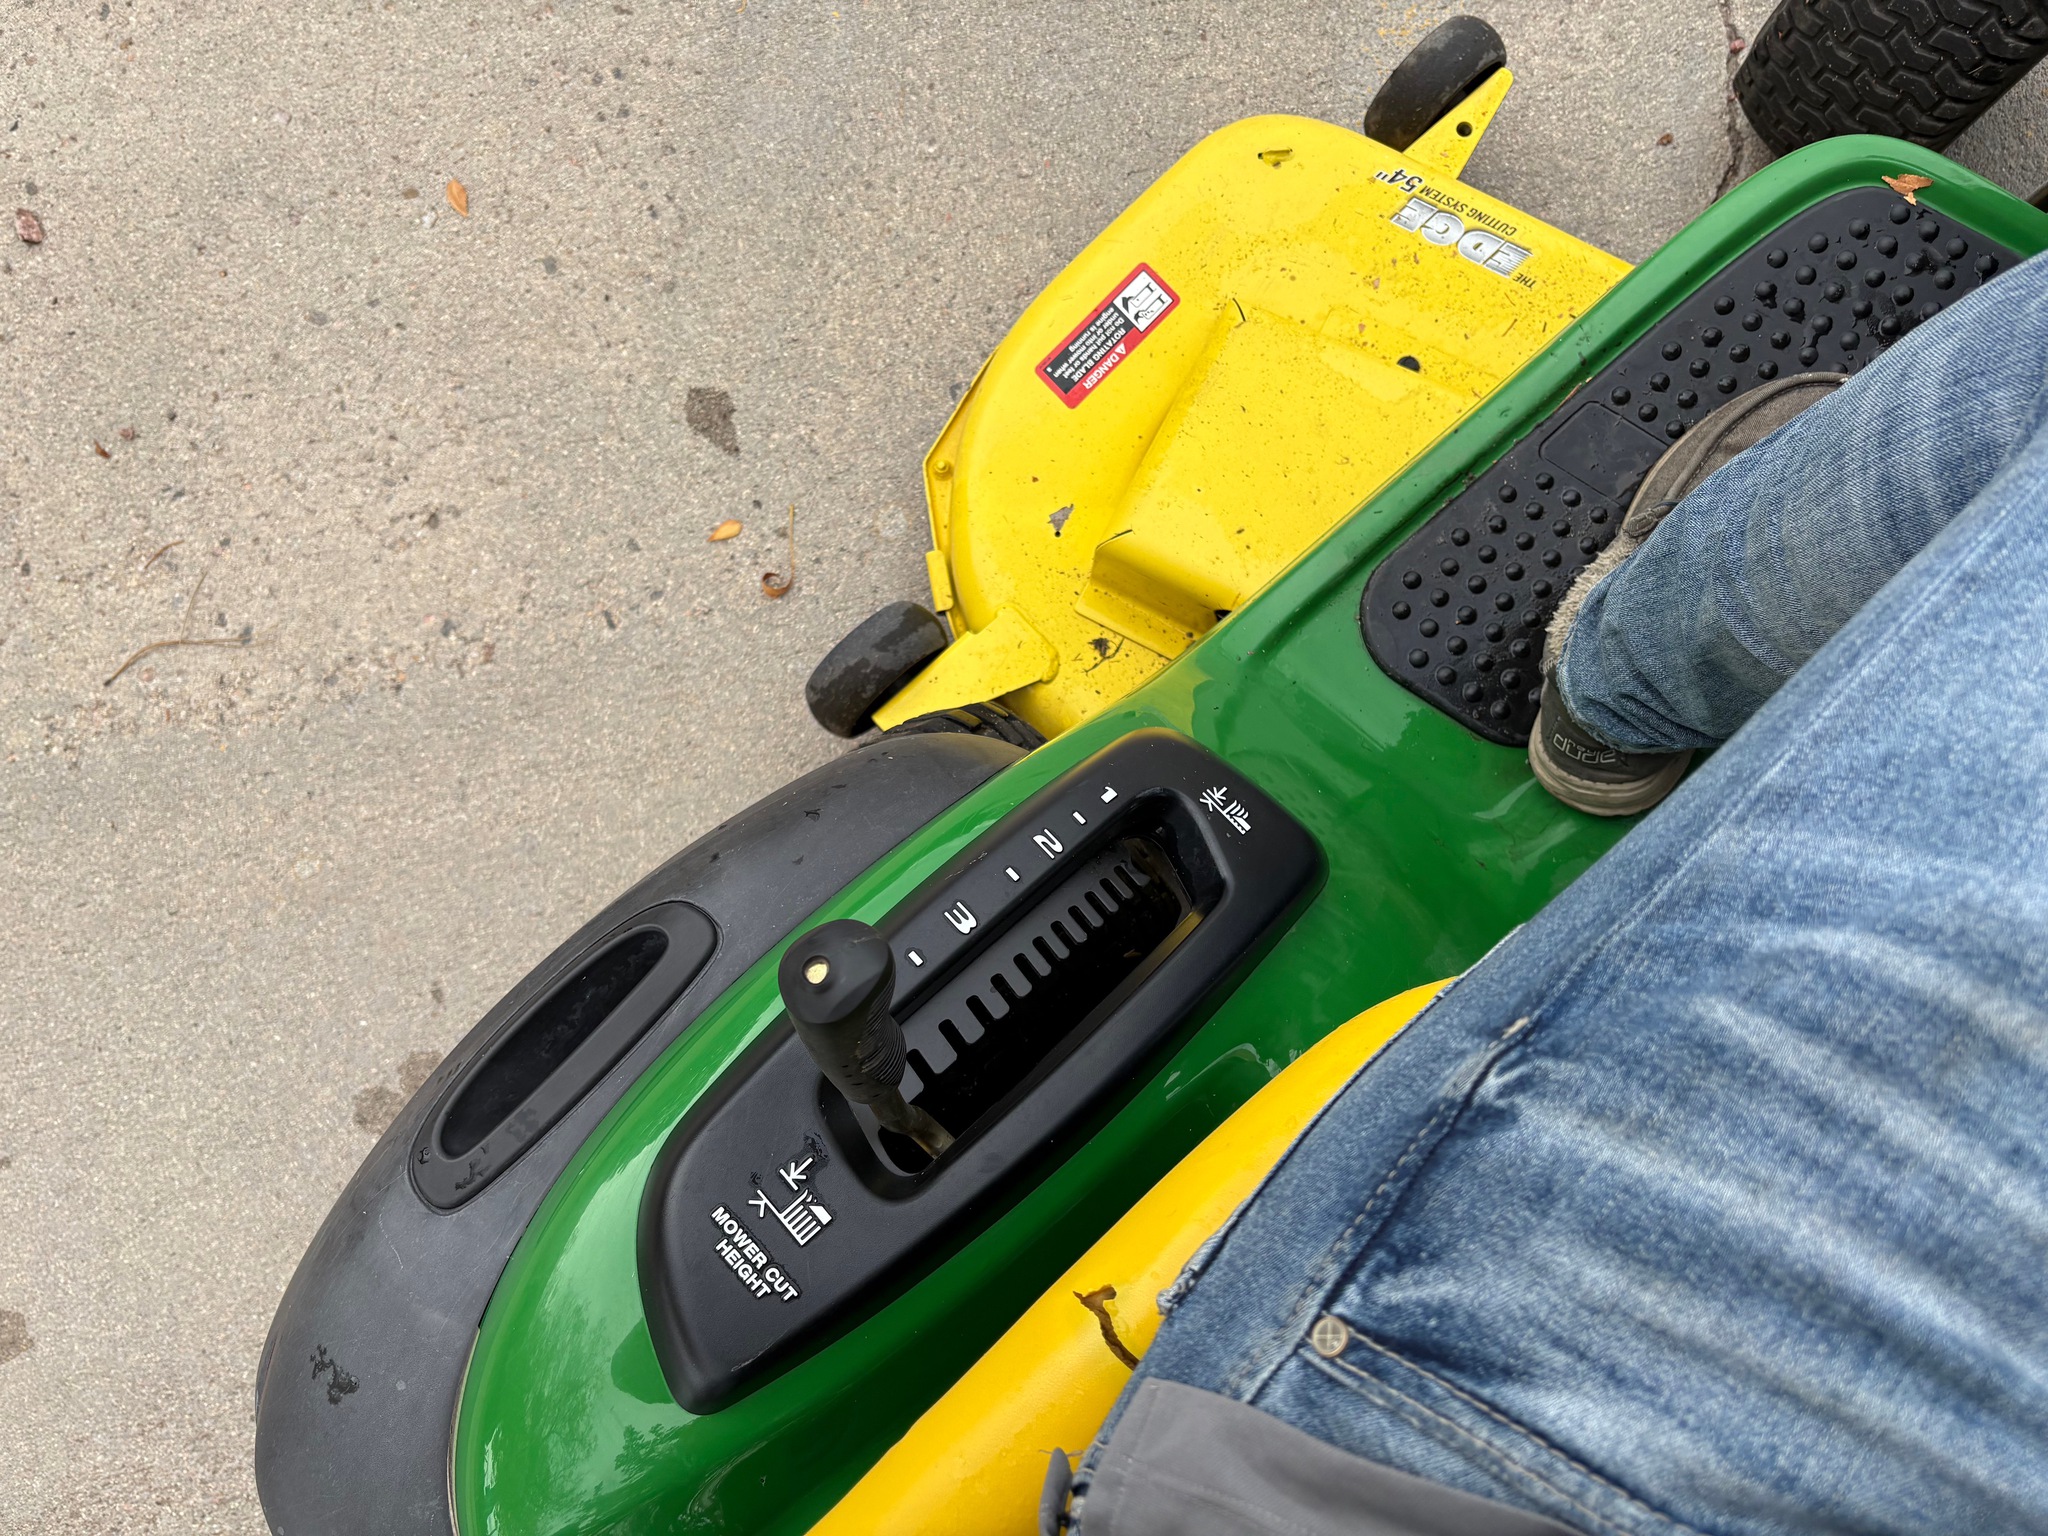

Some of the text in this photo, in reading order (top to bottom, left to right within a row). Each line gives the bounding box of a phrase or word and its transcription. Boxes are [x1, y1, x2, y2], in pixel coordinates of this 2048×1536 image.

[1419, 186, 1468, 212] SYSTEM
[1466, 208, 1517, 235] CUTTING
[1390, 197, 1537, 289] THE EDGE
[1095, 307, 1114, 326] engine
[1102, 312, 1119, 329] under
[1114, 317, 1125, 327] Do
[1085, 334, 1098, 346] into
[1095, 334, 1106, 346] put
[1096, 328, 1104, 336] or
[1105, 325, 1116, 337] not
[1068, 330, 1091, 352] running
[1092, 327, 1126, 361] ROTATING
[1068, 344, 1087, 364] mower
[1079, 344, 1098, 362] hands
[1053, 362, 1069, 378] when
[1062, 366, 1075, 379] feet
[1071, 358, 1095, 382] BLADE
[1073, 360, 1081, 368] or
[1082, 353, 1120, 389] DANGER
[1101, 787, 1118, 804] 1
[1033, 828, 1063, 859] 2
[944, 902, 976, 934] 3
[712, 1206, 798, 1301] MOWER CUT
[716, 1239, 771, 1298] HEIGHT
